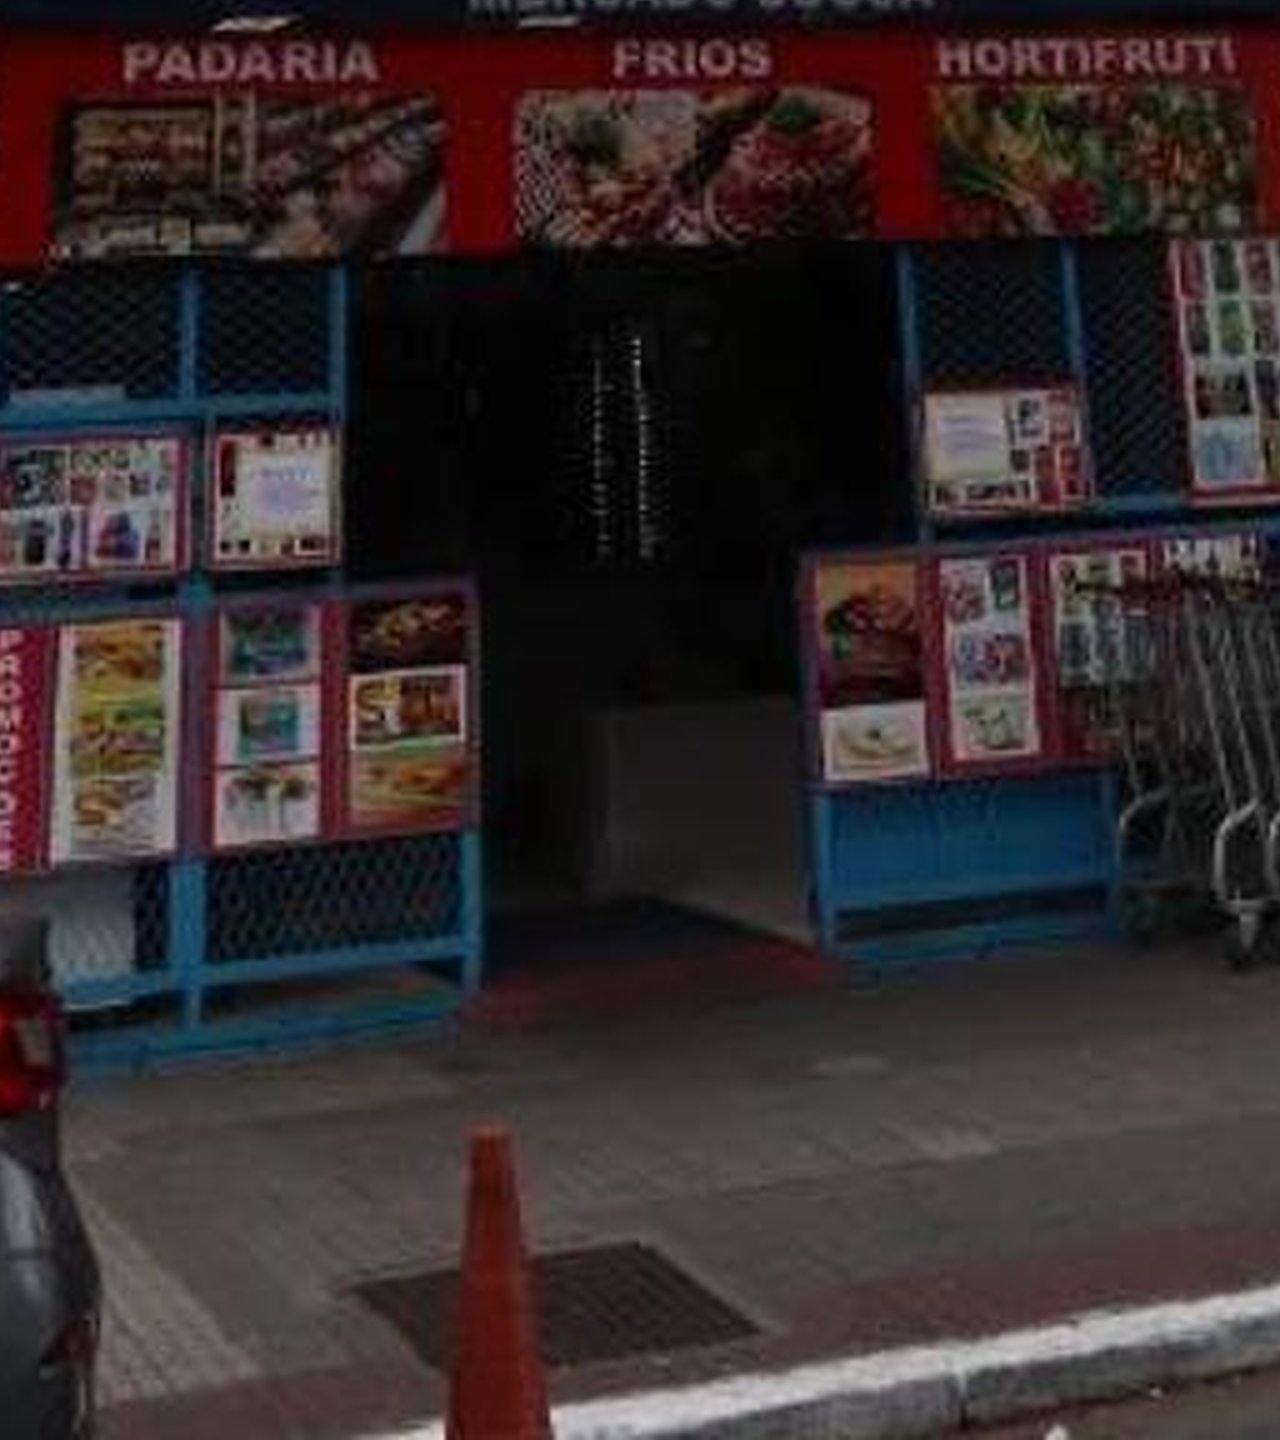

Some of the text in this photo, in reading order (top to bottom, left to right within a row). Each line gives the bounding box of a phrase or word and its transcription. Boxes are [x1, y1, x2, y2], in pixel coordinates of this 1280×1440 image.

[120, 41, 382, 83] PADARIA
[610, 38, 774, 80] FRIOS
[937, 37, 1241, 77] HORTIFRUTI
